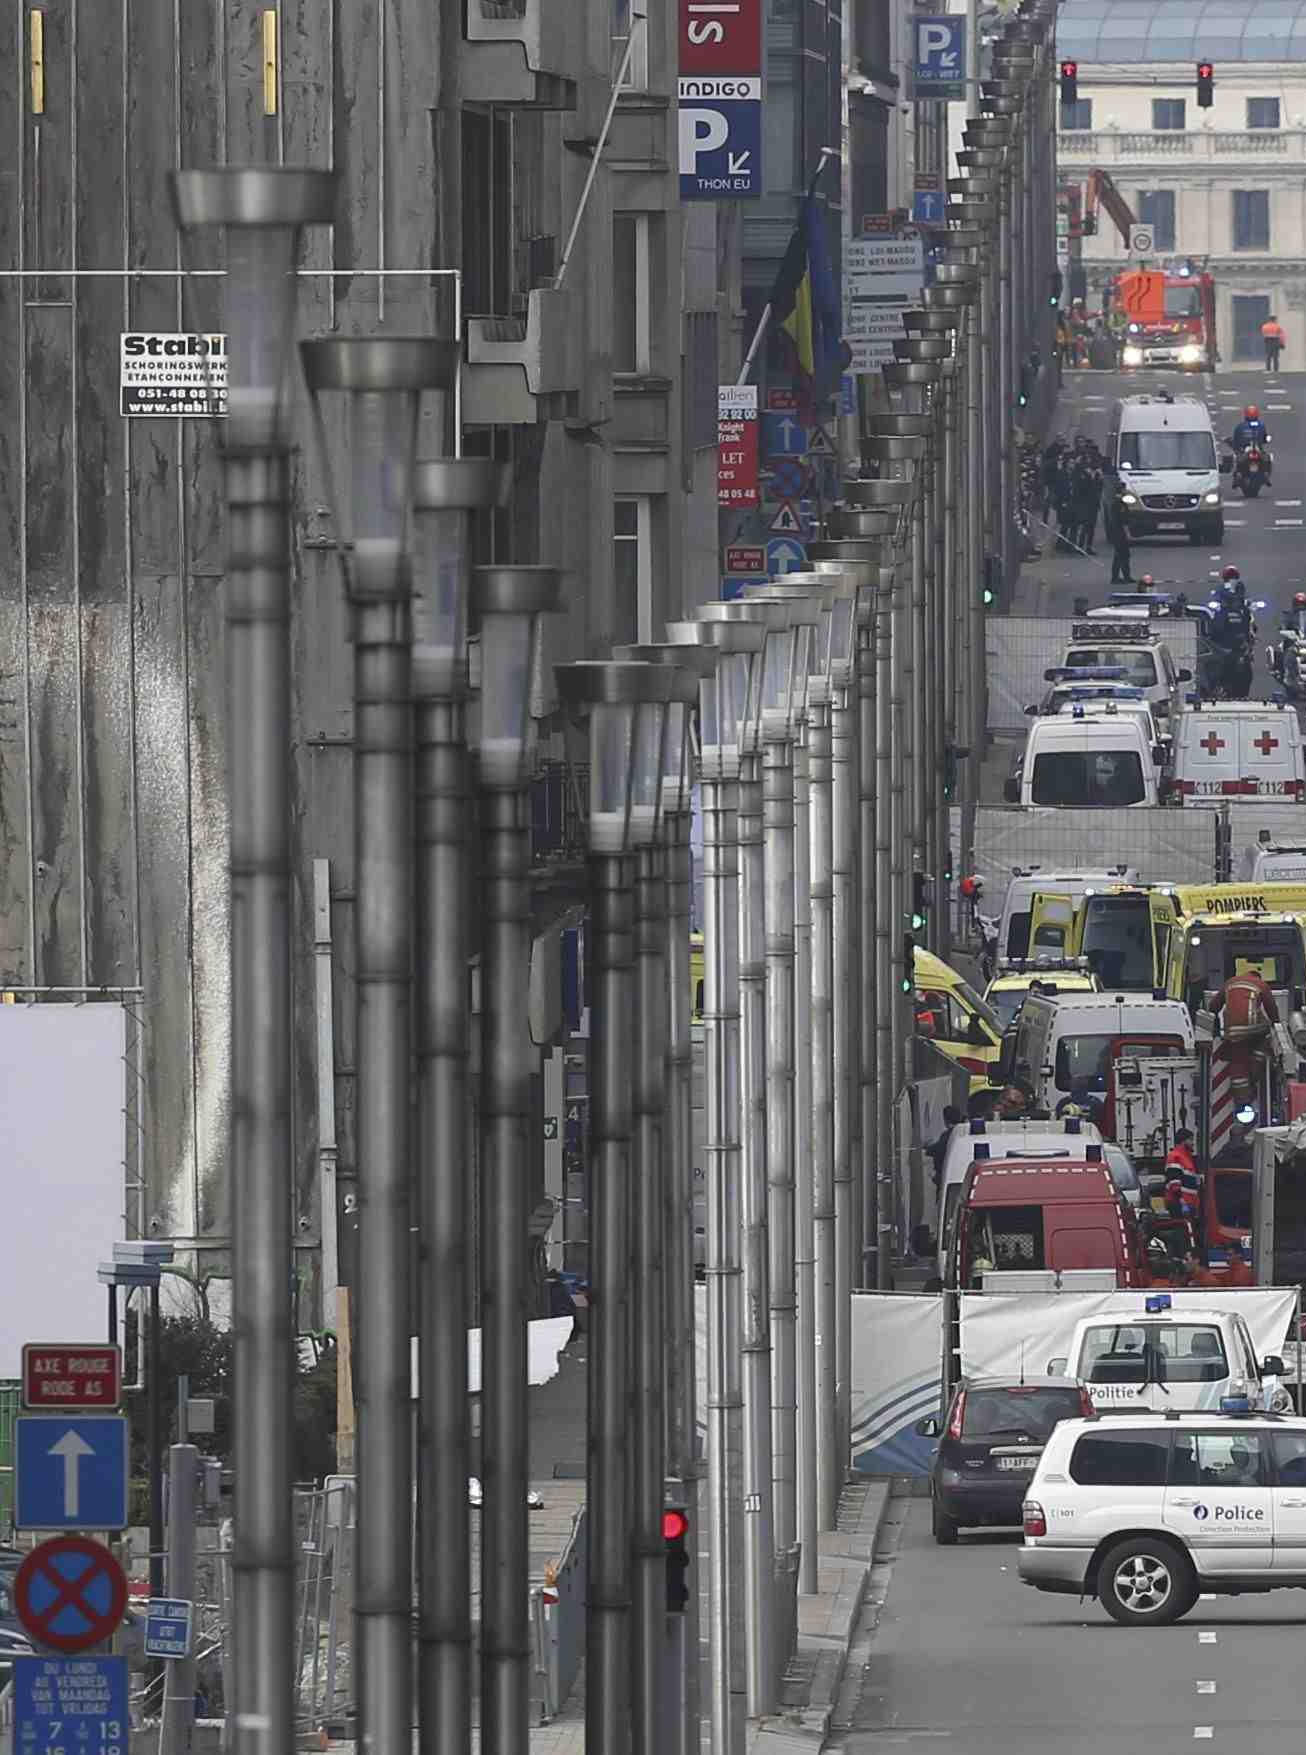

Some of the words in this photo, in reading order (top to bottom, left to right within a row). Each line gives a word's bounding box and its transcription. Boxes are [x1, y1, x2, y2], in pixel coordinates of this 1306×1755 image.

[919, 24, 952, 64] P
[678, 108, 729, 175] P
[698, 179, 731, 190] THON
[734, 179, 751, 190] EU
[189, 388, 207, 399] 08
[722, 452, 744, 464] LET
[1206, 896, 1268, 914] POMPIERS
[34, 1358, 60, 1373] AXE
[68, 1358, 111, 1373] ROUGE
[42, 1381, 76, 1395] RODE
[85, 1381, 103, 1395] AS
[1090, 1387, 1134, 1399] Politie
[1215, 1505, 1264, 1520] Police
[49, 1721, 62, 1739] 7
[100, 1721, 121, 1739] 13
